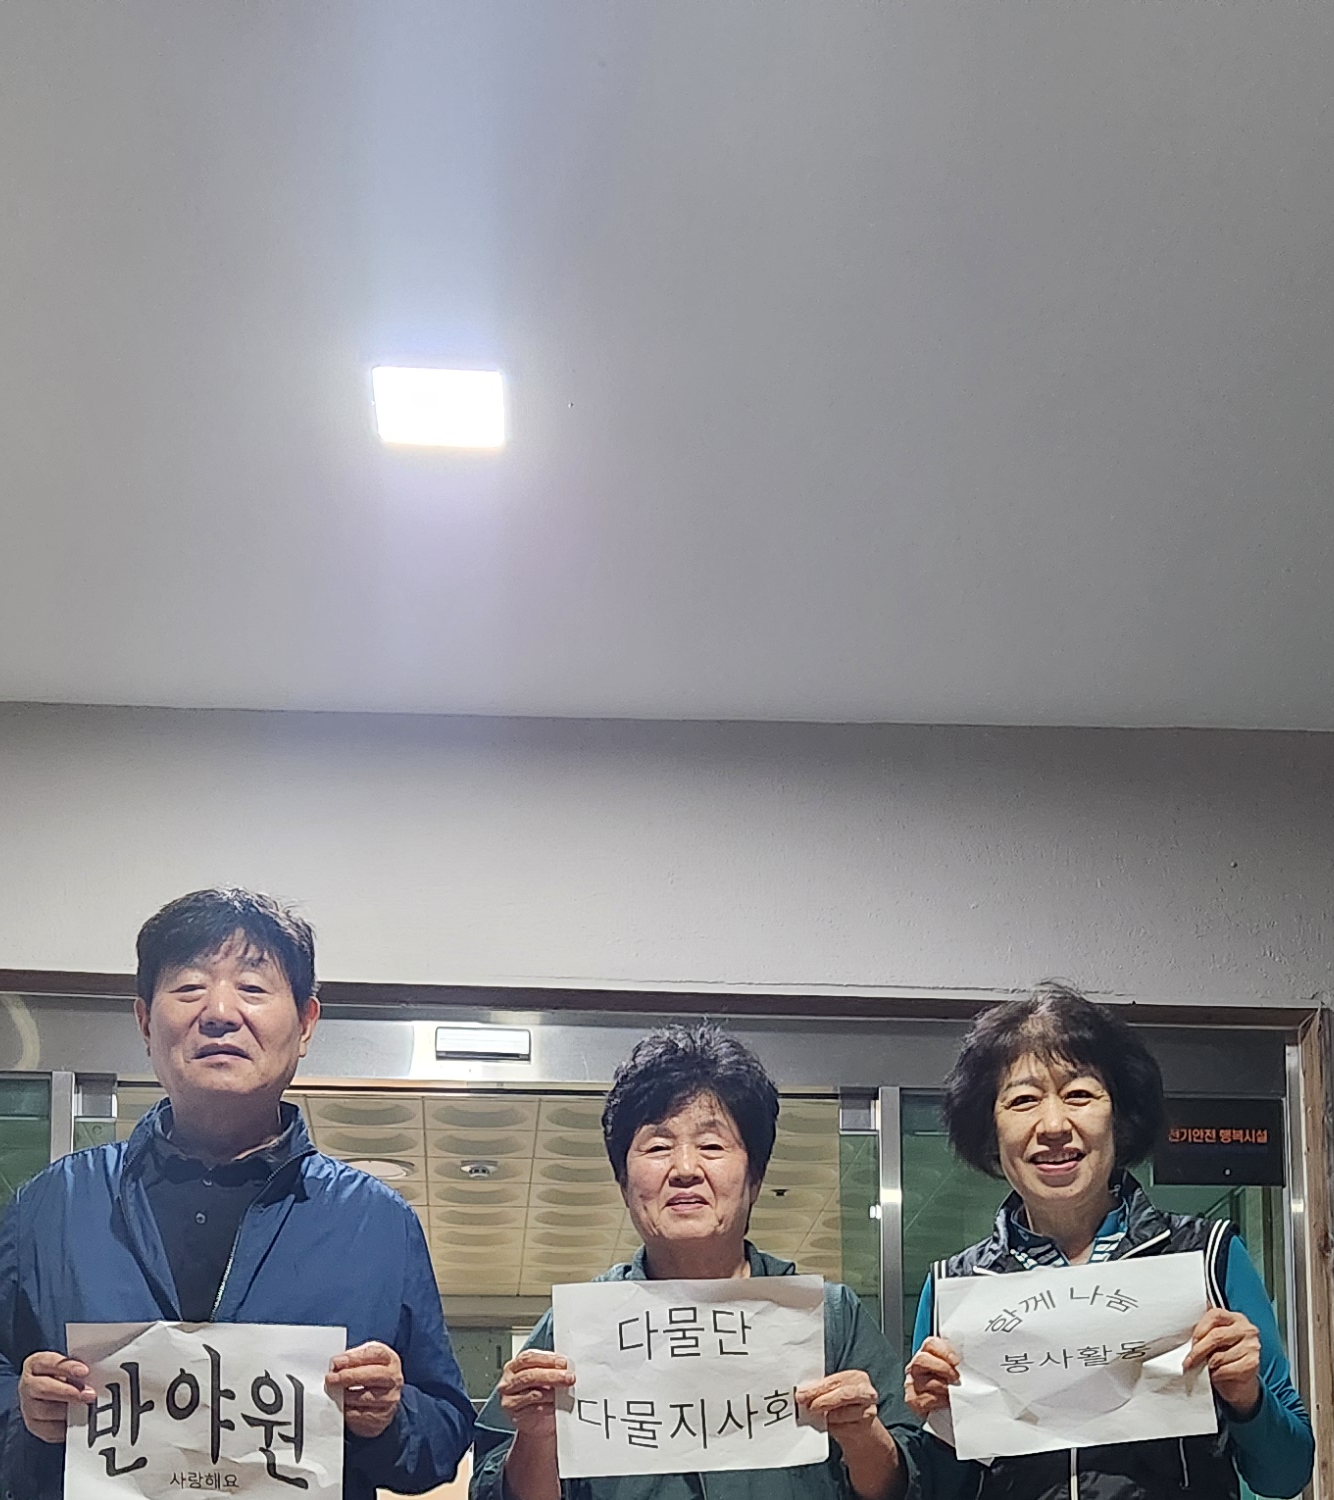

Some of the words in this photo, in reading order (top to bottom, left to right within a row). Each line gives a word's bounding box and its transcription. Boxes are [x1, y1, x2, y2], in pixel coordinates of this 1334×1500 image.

[618, 1306, 752, 1360] 다물단
[984, 1290, 1057, 1333] 함께
[1069, 1284, 1140, 1313] 나눔
[999, 1340, 1152, 1374] 봉사활동
[87, 1343, 309, 1490] 반야원
[577, 1386, 800, 1450] 다물지사회
[169, 1472, 240, 1489] 사랑해요
